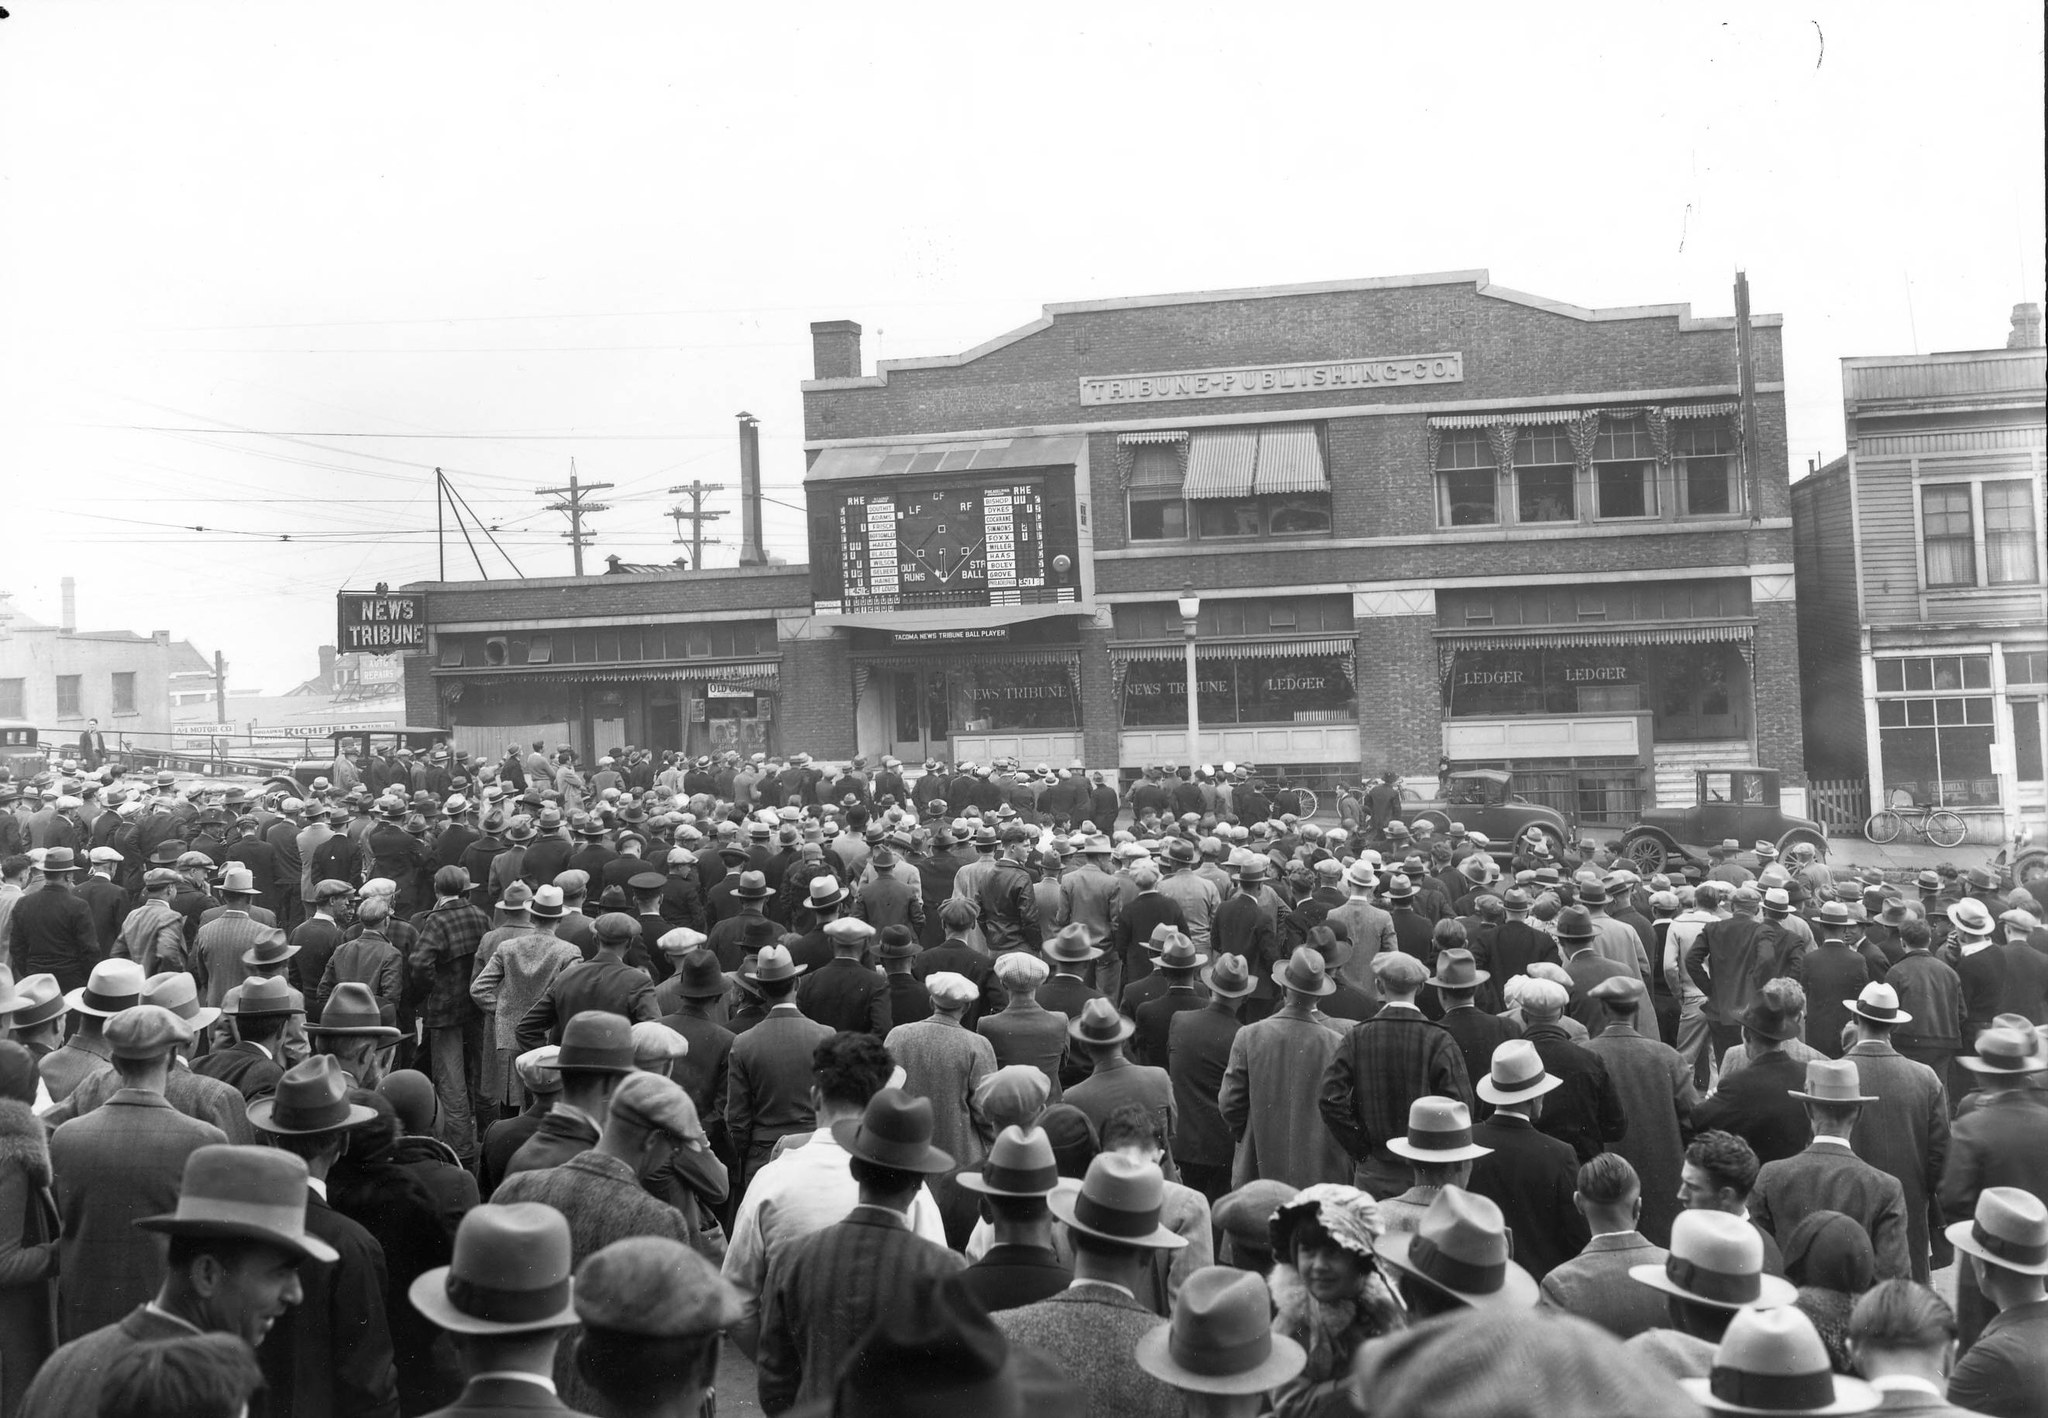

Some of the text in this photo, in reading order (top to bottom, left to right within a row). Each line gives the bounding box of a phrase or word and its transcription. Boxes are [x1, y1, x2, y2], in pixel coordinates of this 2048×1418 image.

[932, 492, 944, 500] CF
[909, 505, 921, 515] LF
[960, 501, 972, 511] RF
[901, 563, 916, 572] OUT
[904, 573, 925, 582] RUNS
[962, 570, 984, 579] BALL
[361, 600, 414, 620] NEWS
[349, 624, 424, 646] TRIBUNE
[1463, 671, 1524, 685] LEDGER
[1566, 667, 1627, 681] LEDGER
[709, 684, 726, 693] OLD
[1125, 680, 1228, 696] NEWS TRUNE
[1268, 677, 1326, 691] LEDGER
[963, 686, 1068, 701] NEWS TRIBUNE
